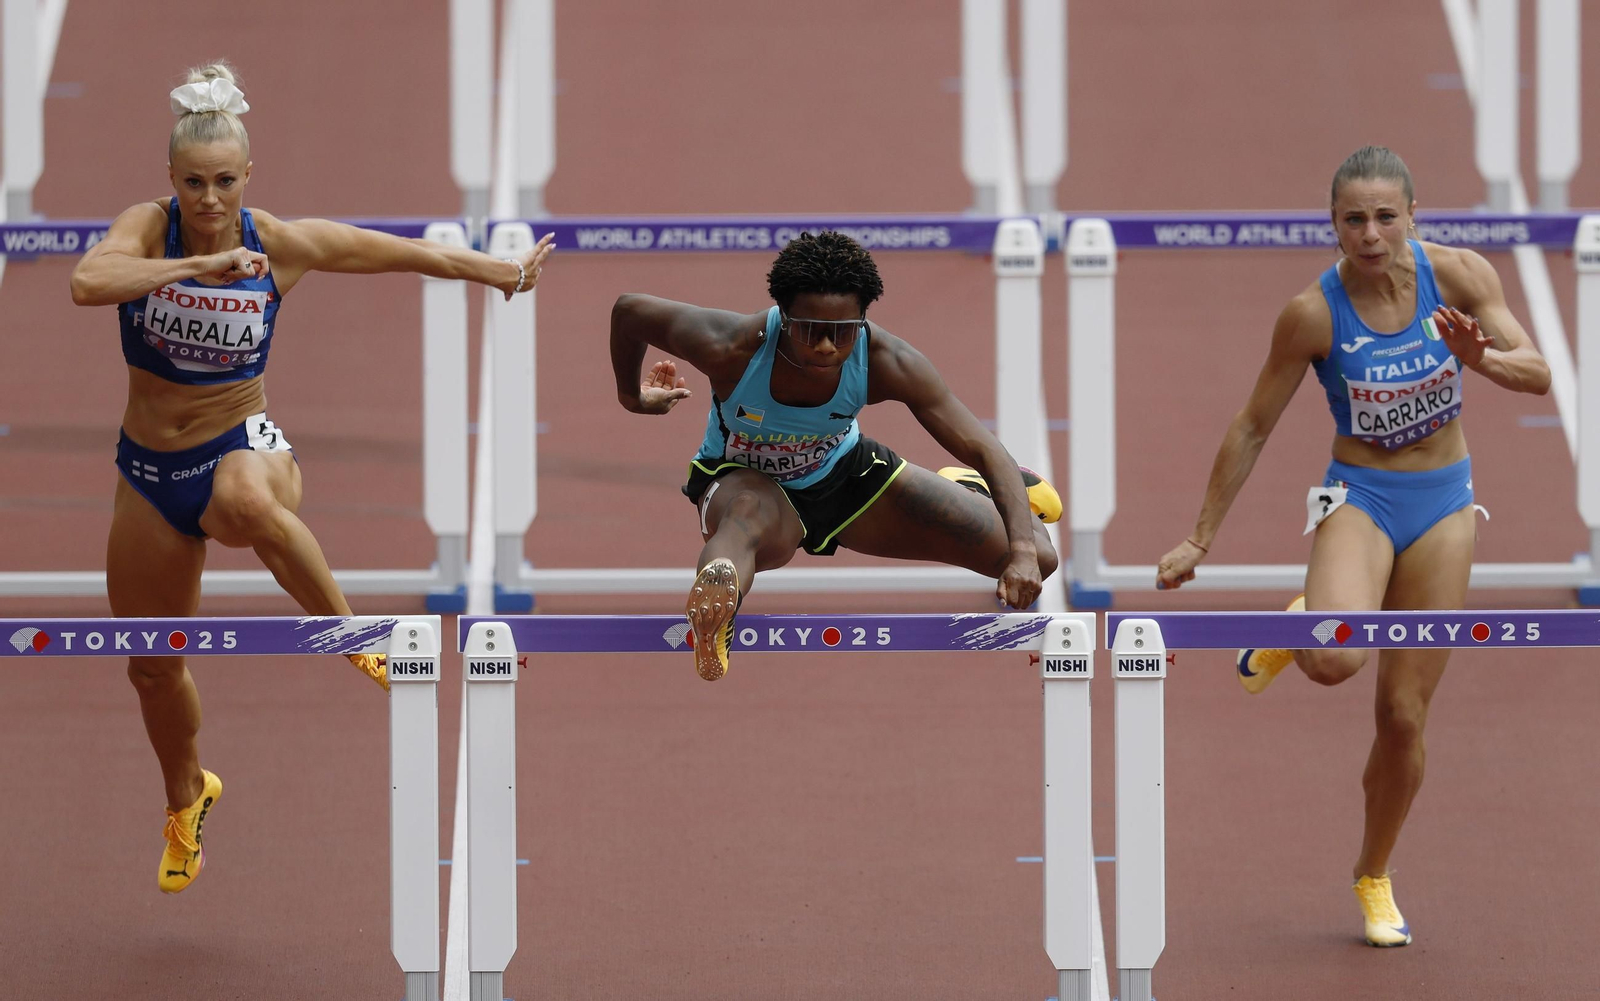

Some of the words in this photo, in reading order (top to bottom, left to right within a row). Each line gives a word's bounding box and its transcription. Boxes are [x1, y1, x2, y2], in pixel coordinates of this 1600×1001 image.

[4, 231, 79, 251] WORLD
[576, 228, 655, 249] WORLD
[658, 227, 772, 249] ATHLETICS
[1153, 224, 1233, 245] WORLD
[1236, 223, 1338, 245] ATHLETIC
[1418, 221, 1530, 243] PIONSHIPS
[152, 285, 262, 314] HONDA
[151, 308, 254, 348] HARALA
[1365, 354, 1440, 382] ITALIA
[1350, 369, 1456, 403] HONDA
[1358, 386, 1453, 433] CARRARO
[259, 422, 277, 449] 5
[171, 456, 215, 482] CRAFT
[393, 662, 434, 675] NISHI
[470, 662, 511, 675] NISHI
[1046, 659, 1087, 672] NISHI
[1119, 659, 1160, 672] NISHI
